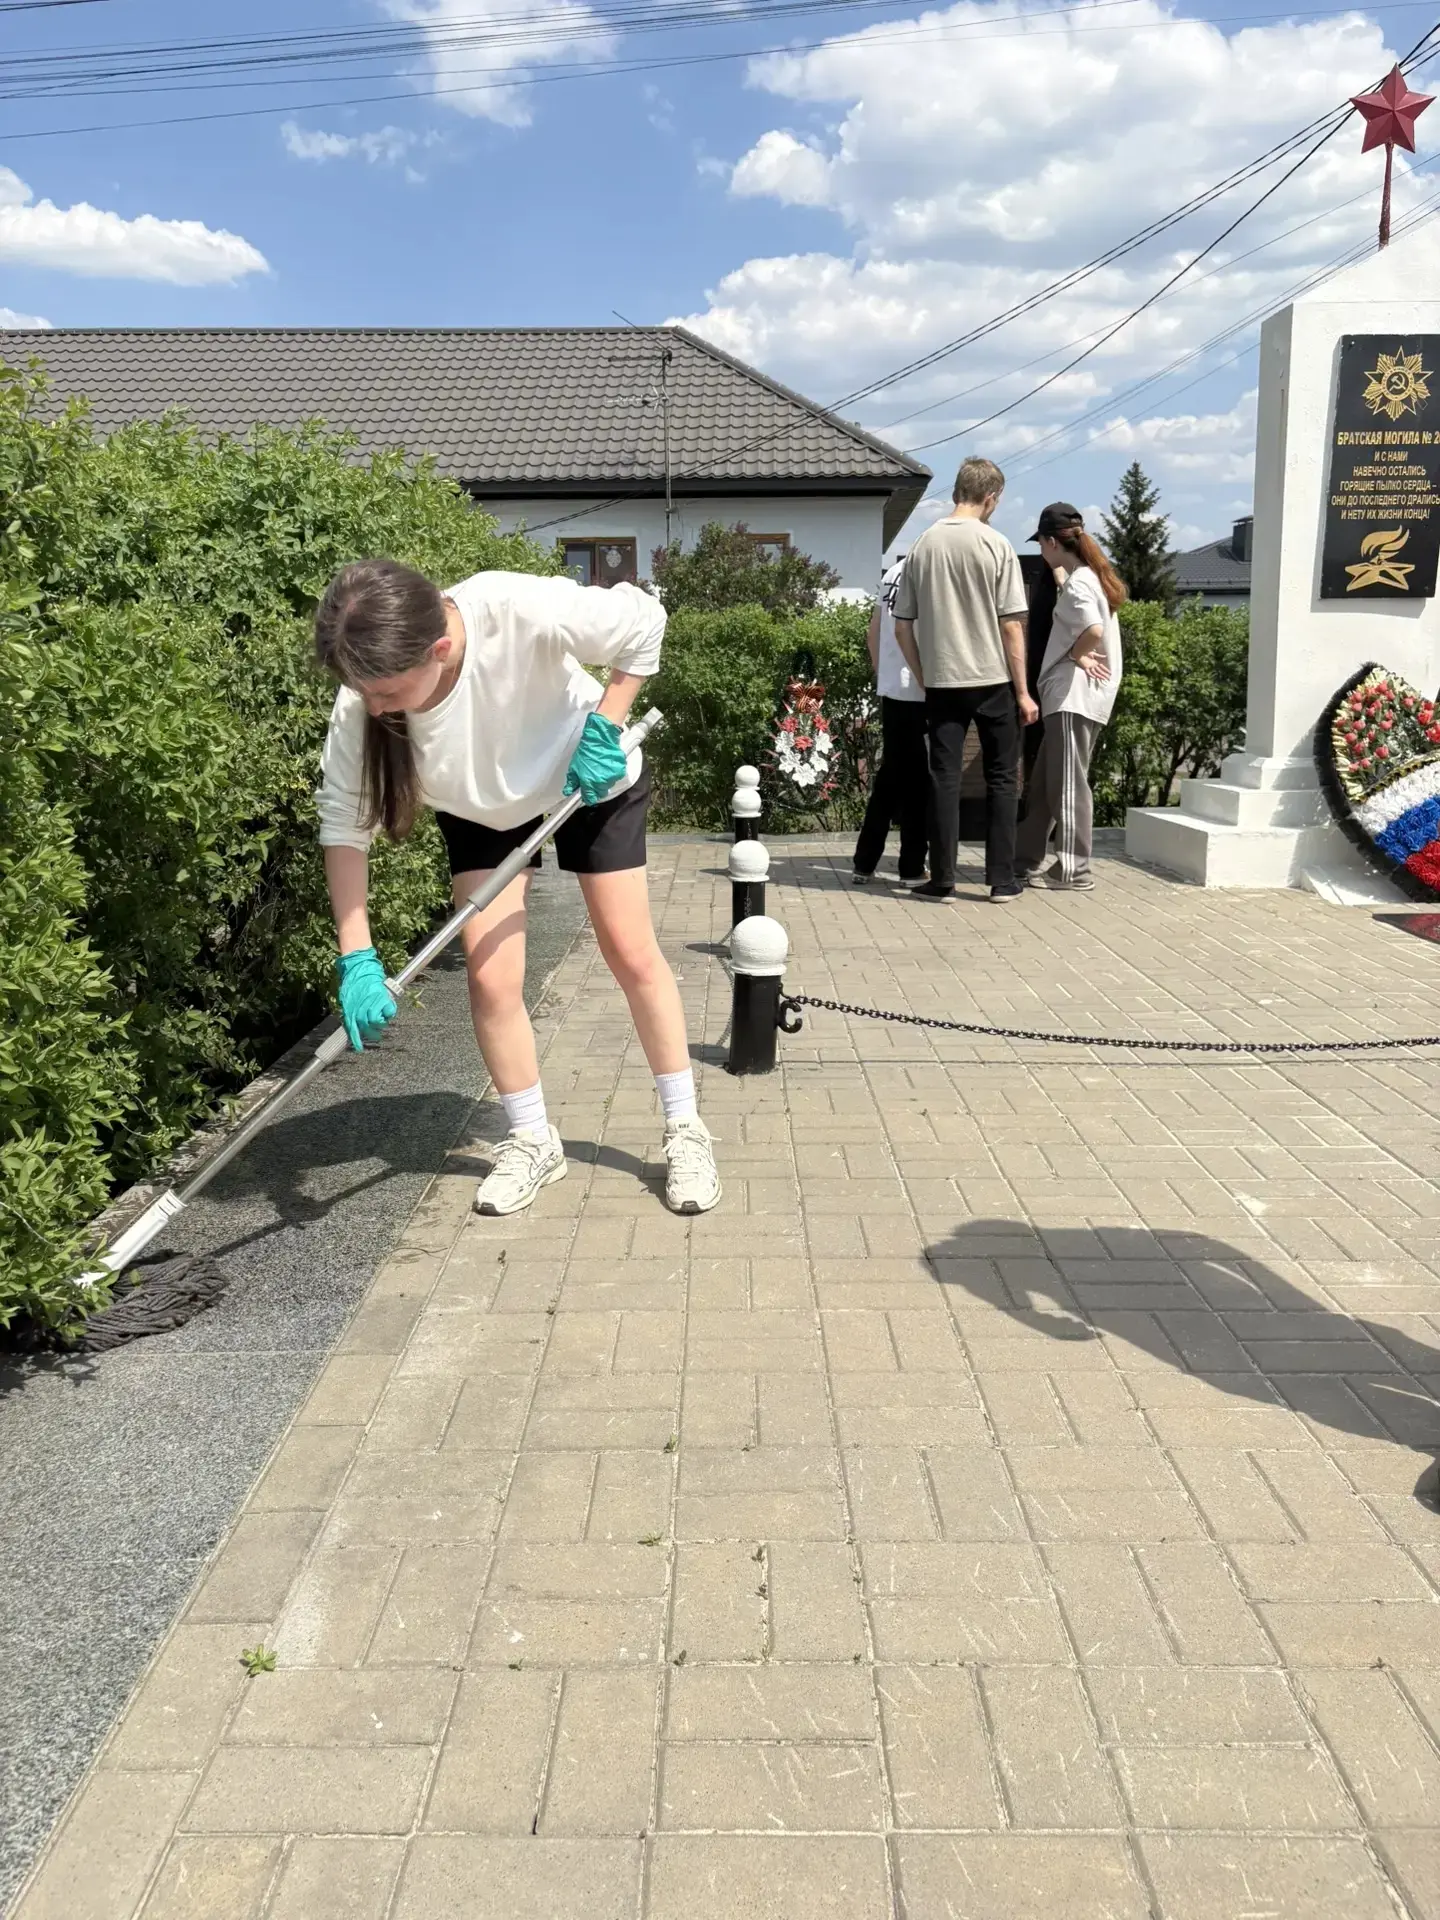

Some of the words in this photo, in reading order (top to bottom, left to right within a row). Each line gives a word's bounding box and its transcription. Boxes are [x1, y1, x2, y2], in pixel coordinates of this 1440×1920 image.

[1337, 431, 1381, 445] БРАТСКАЯ
[1384, 430, 1420, 445] МОГИЛА
[1422, 430, 1432, 444] №
[1434, 430, 1440, 444] 2
[1374, 451, 1380, 461] И
[1381, 451, 1387, 461] С
[1387, 451, 1408, 461] НАМИ
[1353, 466, 1387, 476] НАВЕЧНО
[1388, 465, 1427, 476] ОСТАЛИСЬ
[1340, 480, 1375, 492] ГОРЯЩИЕ
[1376, 480, 1401, 491] ПЫЛКО
[1402, 480, 1431, 492] СЕРДЦА
[1331, 495, 1347, 506] ОНИ
[1347, 495, 1357, 507] ДО
[1359, 494, 1406, 506] ПОСЛЕДНЕГО
[1341, 509, 1347, 520] И
[1347, 509, 1366, 520] НЕТУ
[1366, 509, 1377, 519] ИХ
[1377, 509, 1403, 519] ЖИЗНИ
[1404, 508, 1430, 520] КОНЦА!
